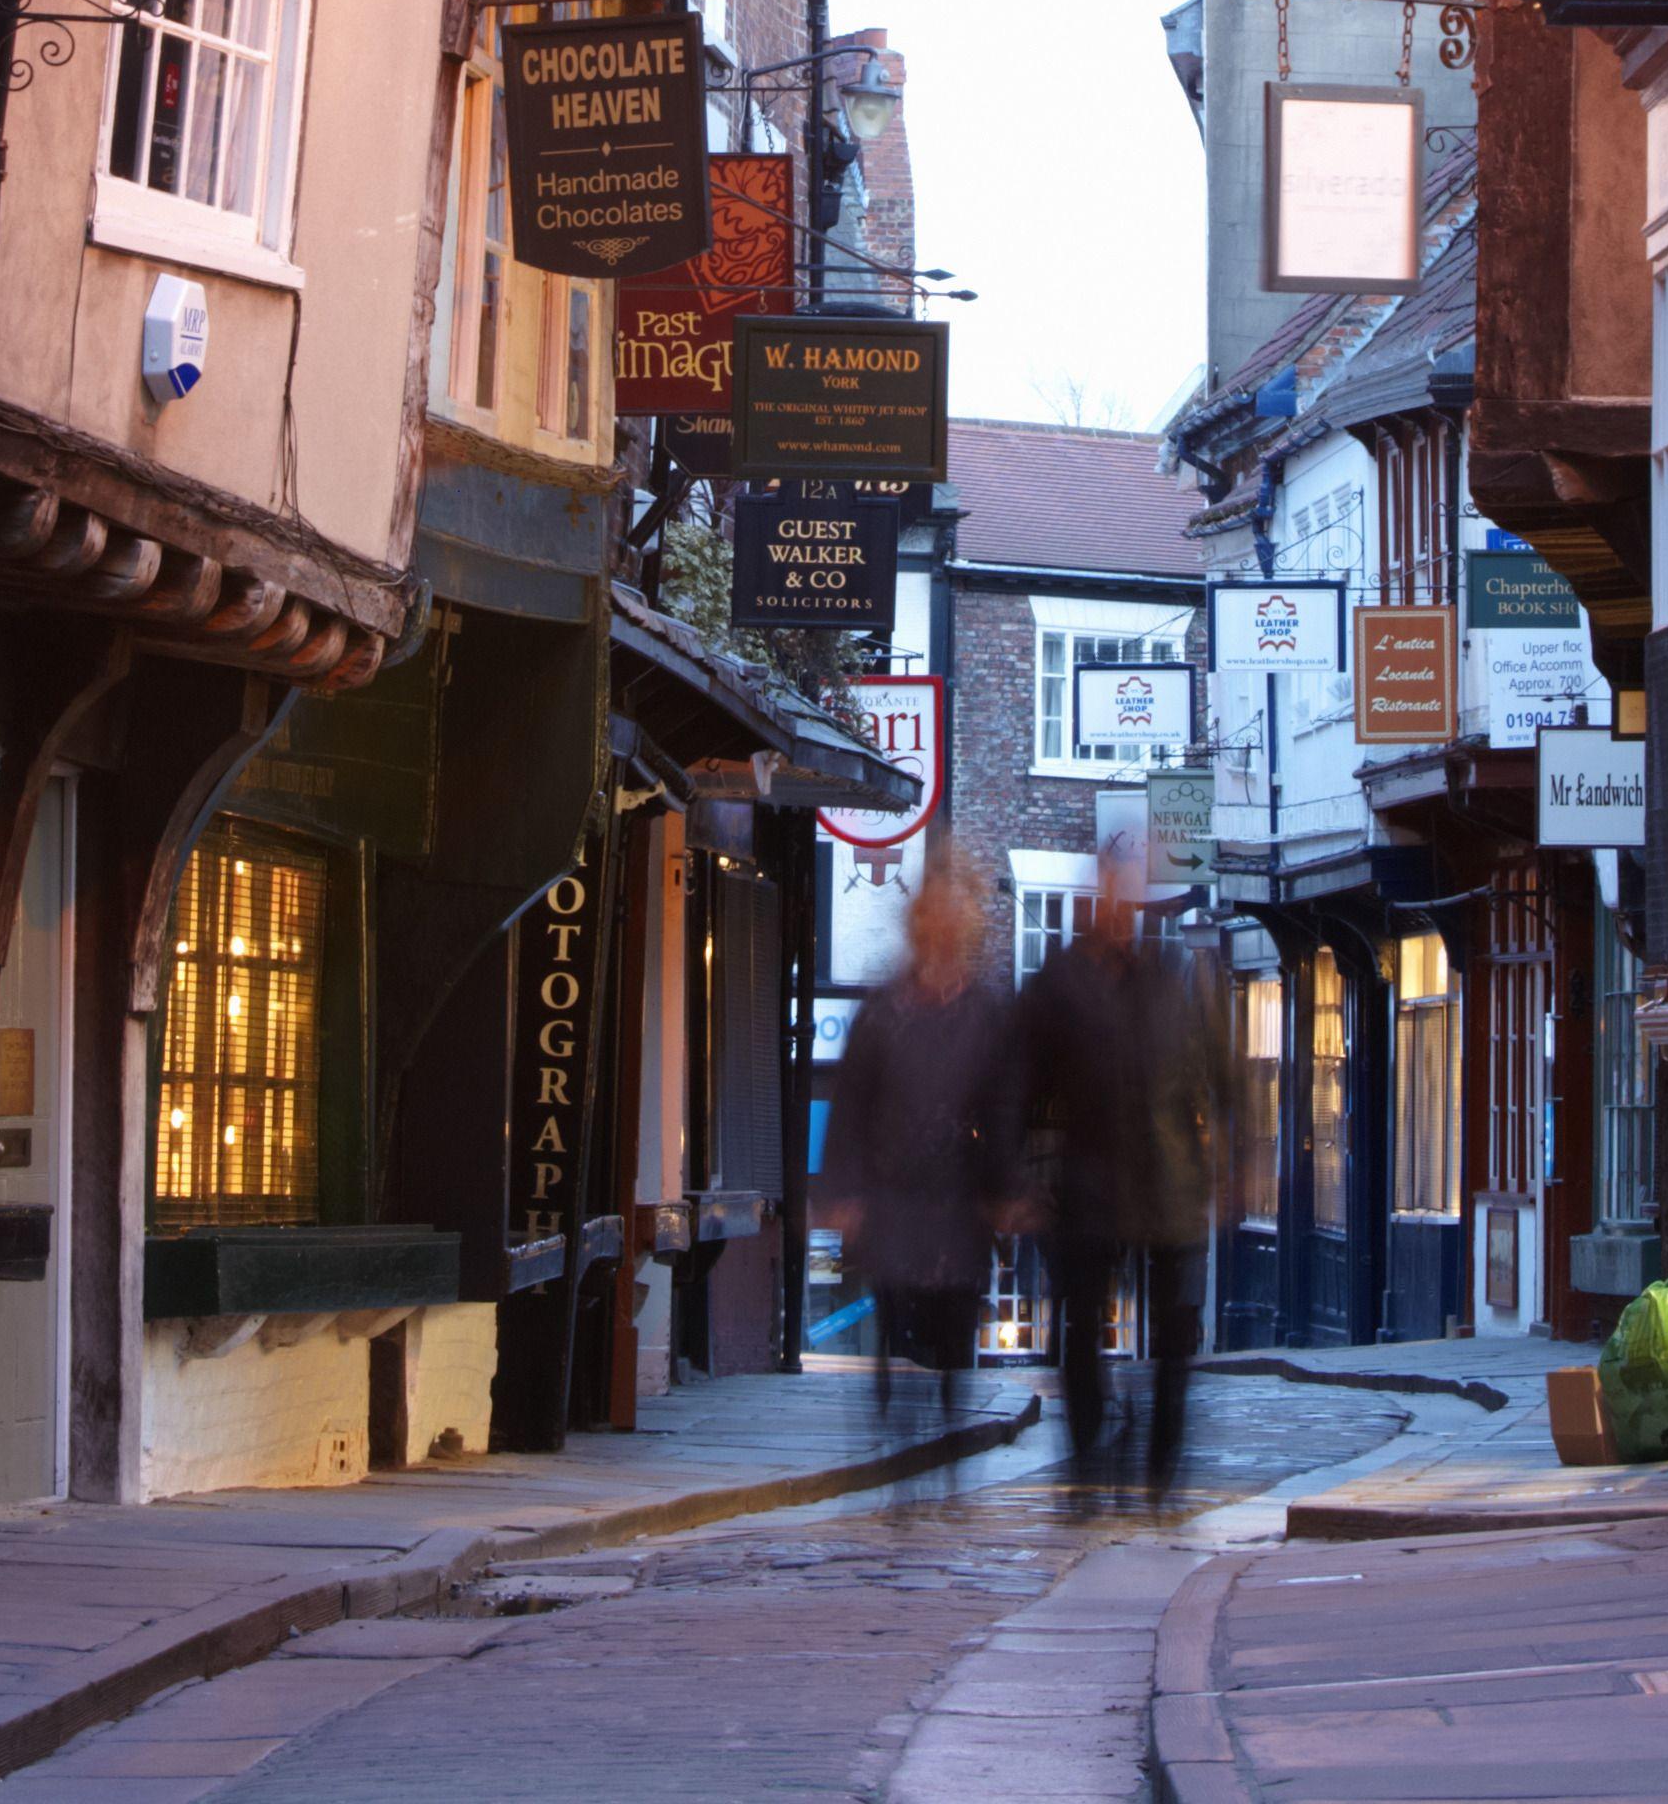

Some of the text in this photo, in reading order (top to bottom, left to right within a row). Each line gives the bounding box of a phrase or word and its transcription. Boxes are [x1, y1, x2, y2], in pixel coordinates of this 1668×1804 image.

[522, 38, 685, 85] CHOCOLATE
[551, 86, 661, 129] HEAVEN
[537, 164, 679, 197] Handmade
[537, 199, 682, 230] Chocolates
[637, 311, 701, 337] Past
[765, 342, 920, 372] W. HAMOND
[822, 375, 860, 390] YORK
[754, 402, 927, 417] THE ORIGINAL WHITBY JET SHOP
[777, 441, 901, 453] www.whamond.com
[778, 519, 856, 540] GUEST
[767, 545, 866, 565] WALKER
[785, 571, 846, 589] & CO
[756, 596, 873, 609] SOLICITORS
[1498, 602, 1546, 615] BOOK
[1255, 619, 1299, 627] LEATHER
[1263, 628, 1291, 636] SHOP
[1523, 642, 1559, 657] Upper
[1375, 665, 1436, 681] Locanda
[1493, 661, 1527, 675] Office
[1509, 677, 1554, 692] Approx.
[1372, 696, 1441, 713] Ristorante
[1506, 711, 1553, 729] 01904
[1550, 774, 1572, 806] Mr
